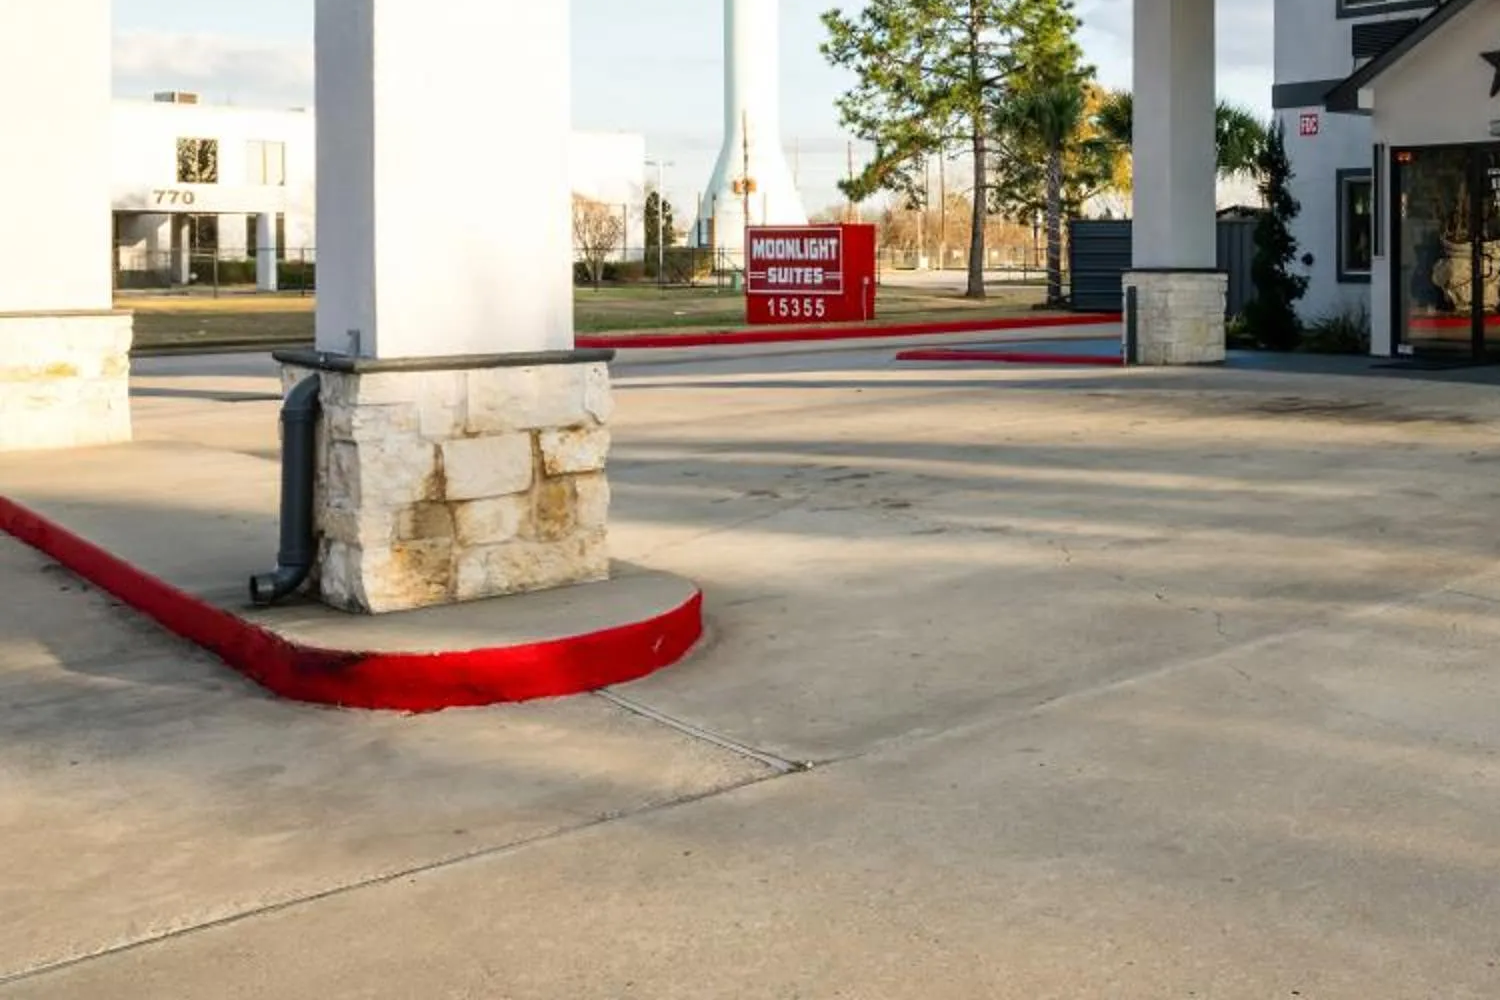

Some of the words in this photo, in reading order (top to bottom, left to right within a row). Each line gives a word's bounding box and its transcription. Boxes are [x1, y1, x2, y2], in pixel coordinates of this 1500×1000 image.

[153, 189, 195, 205] 770
[752, 238, 837, 260] MOONLIGHT
[767, 267, 823, 284] SUITES
[767, 298, 825, 317] 15355
